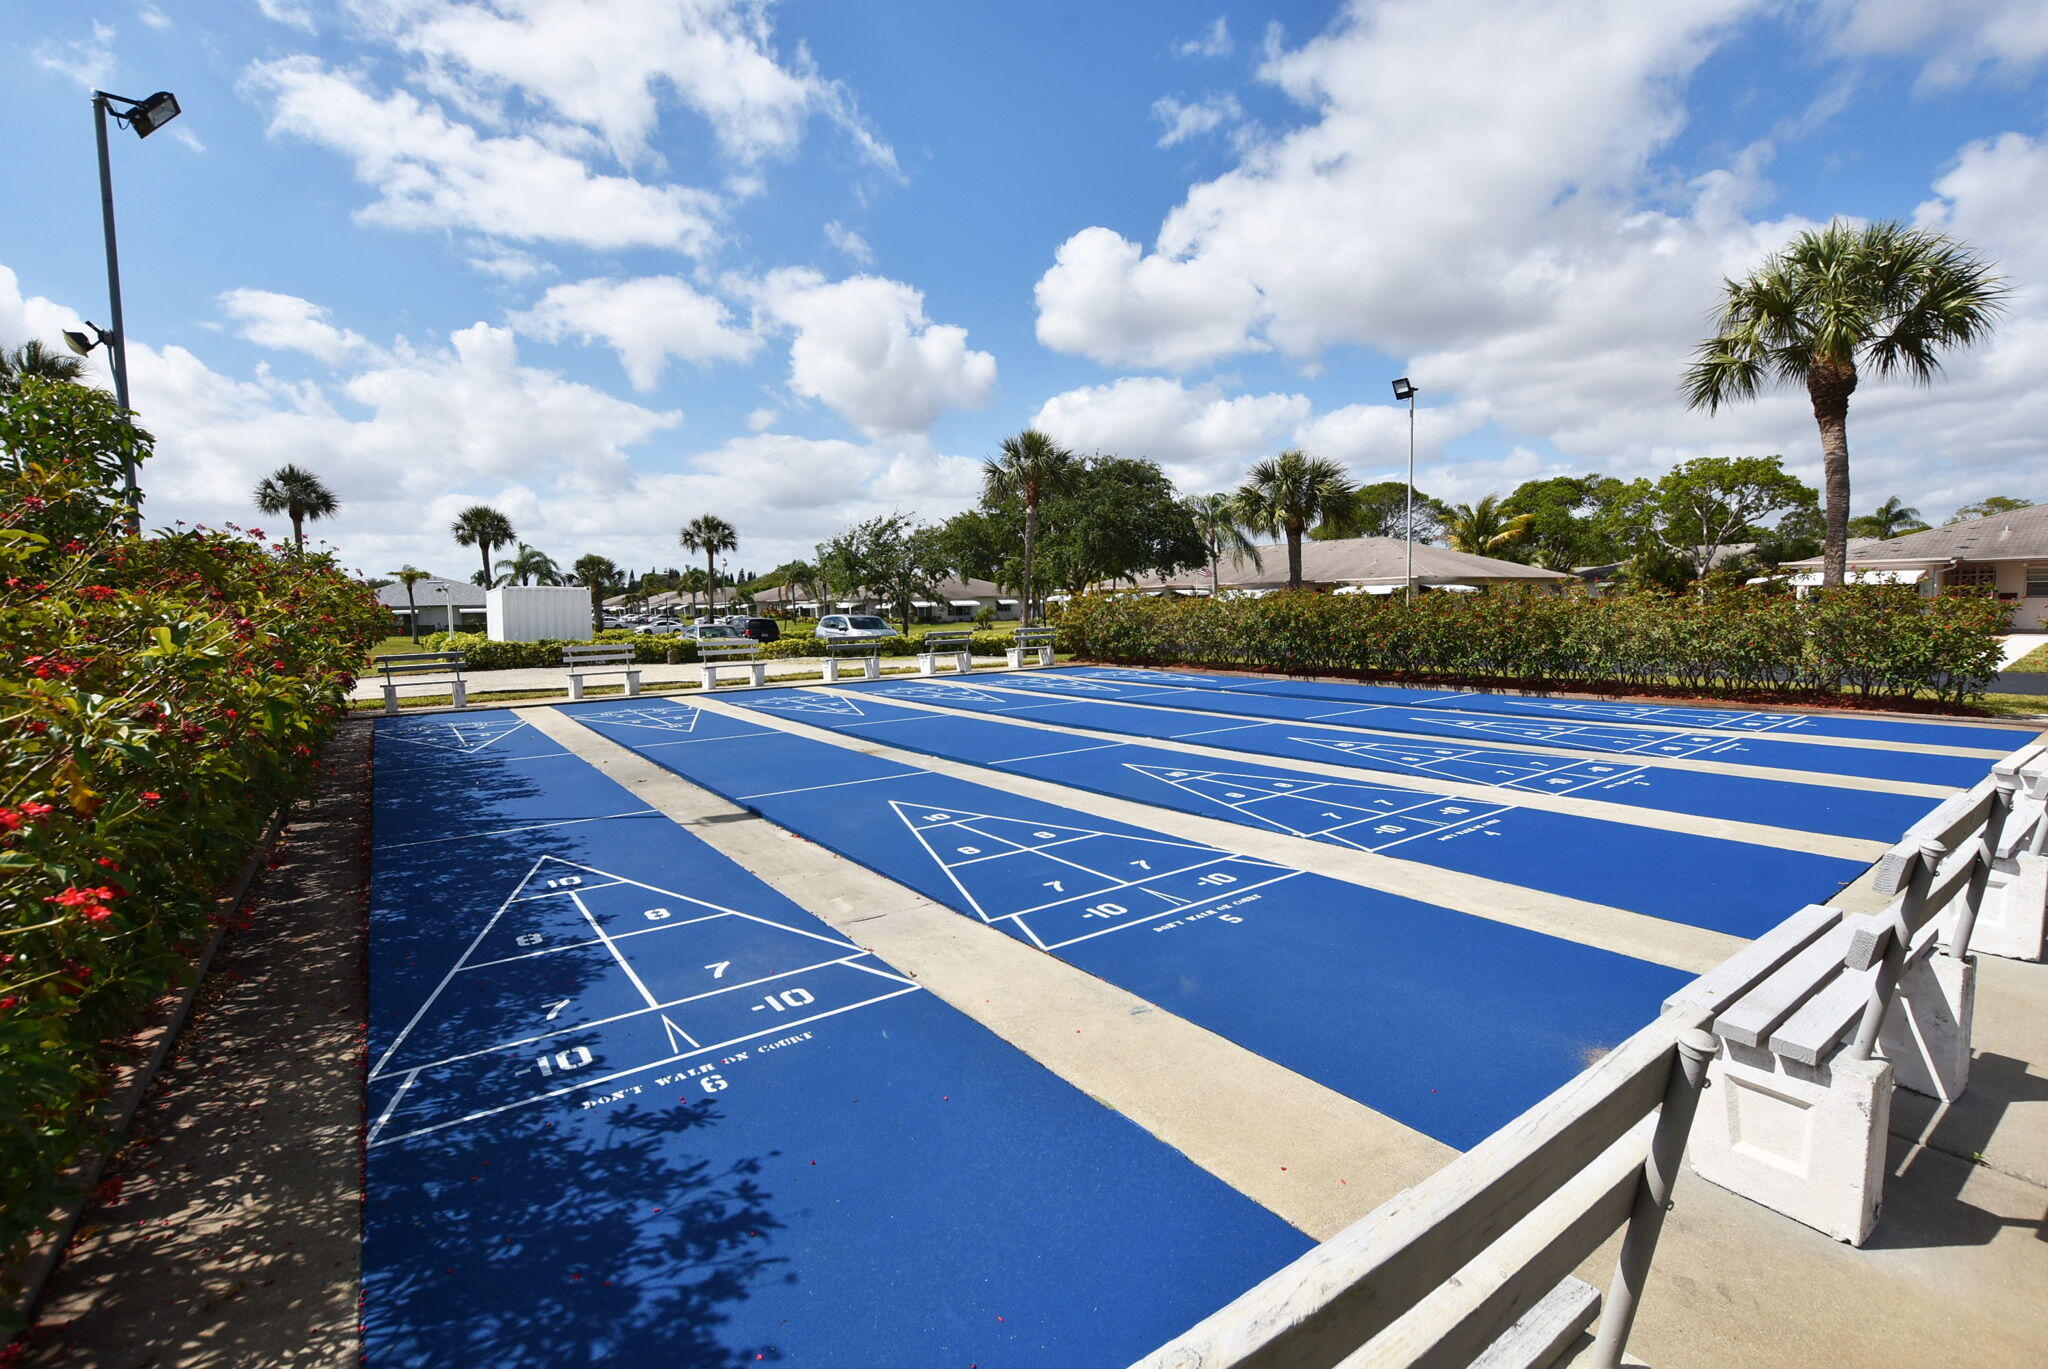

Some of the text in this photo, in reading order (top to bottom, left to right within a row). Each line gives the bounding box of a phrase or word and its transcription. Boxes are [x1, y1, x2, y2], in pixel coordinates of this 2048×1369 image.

[922, 813, 951, 822] 10
[1321, 812, 1342, 820] 7
[956, 831, 1057, 855] 8 8
[547, 875, 582, 889] 10
[1042, 859, 1152, 892] 7 7
[1082, 873, 1237, 919] -10 -10
[515, 908, 671, 947] 8 8
[1218, 914, 1243, 923] 5
[541, 960, 730, 1020] 7 7
[515, 988, 815, 1077] -10 -10
[581, 1031, 814, 1110] DON'T WALK ON COURT
[700, 1074, 728, 1093] 6
